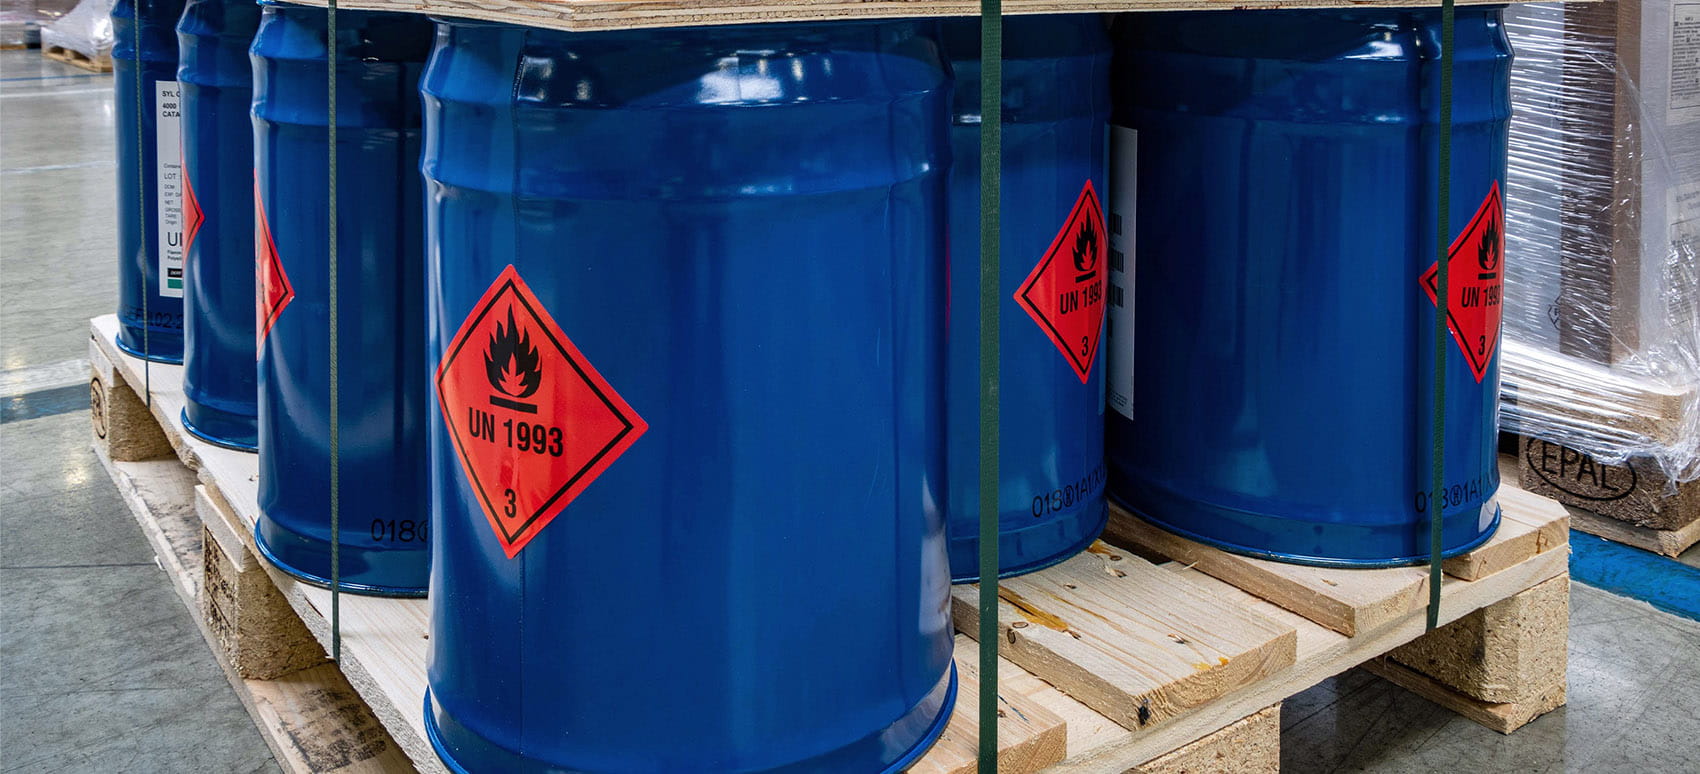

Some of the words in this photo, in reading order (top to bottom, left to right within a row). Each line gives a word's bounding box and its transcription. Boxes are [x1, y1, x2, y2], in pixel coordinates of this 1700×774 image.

[1060, 290, 1078, 315] UN
[1462, 286, 1480, 308] UN
[1082, 336, 1089, 357] 3
[1478, 335, 1486, 356] 3
[469, 407, 495, 443] UN
[503, 418, 564, 457] 1993
[1541, 440, 1619, 492] EPAL
[504, 488, 517, 518] 3
